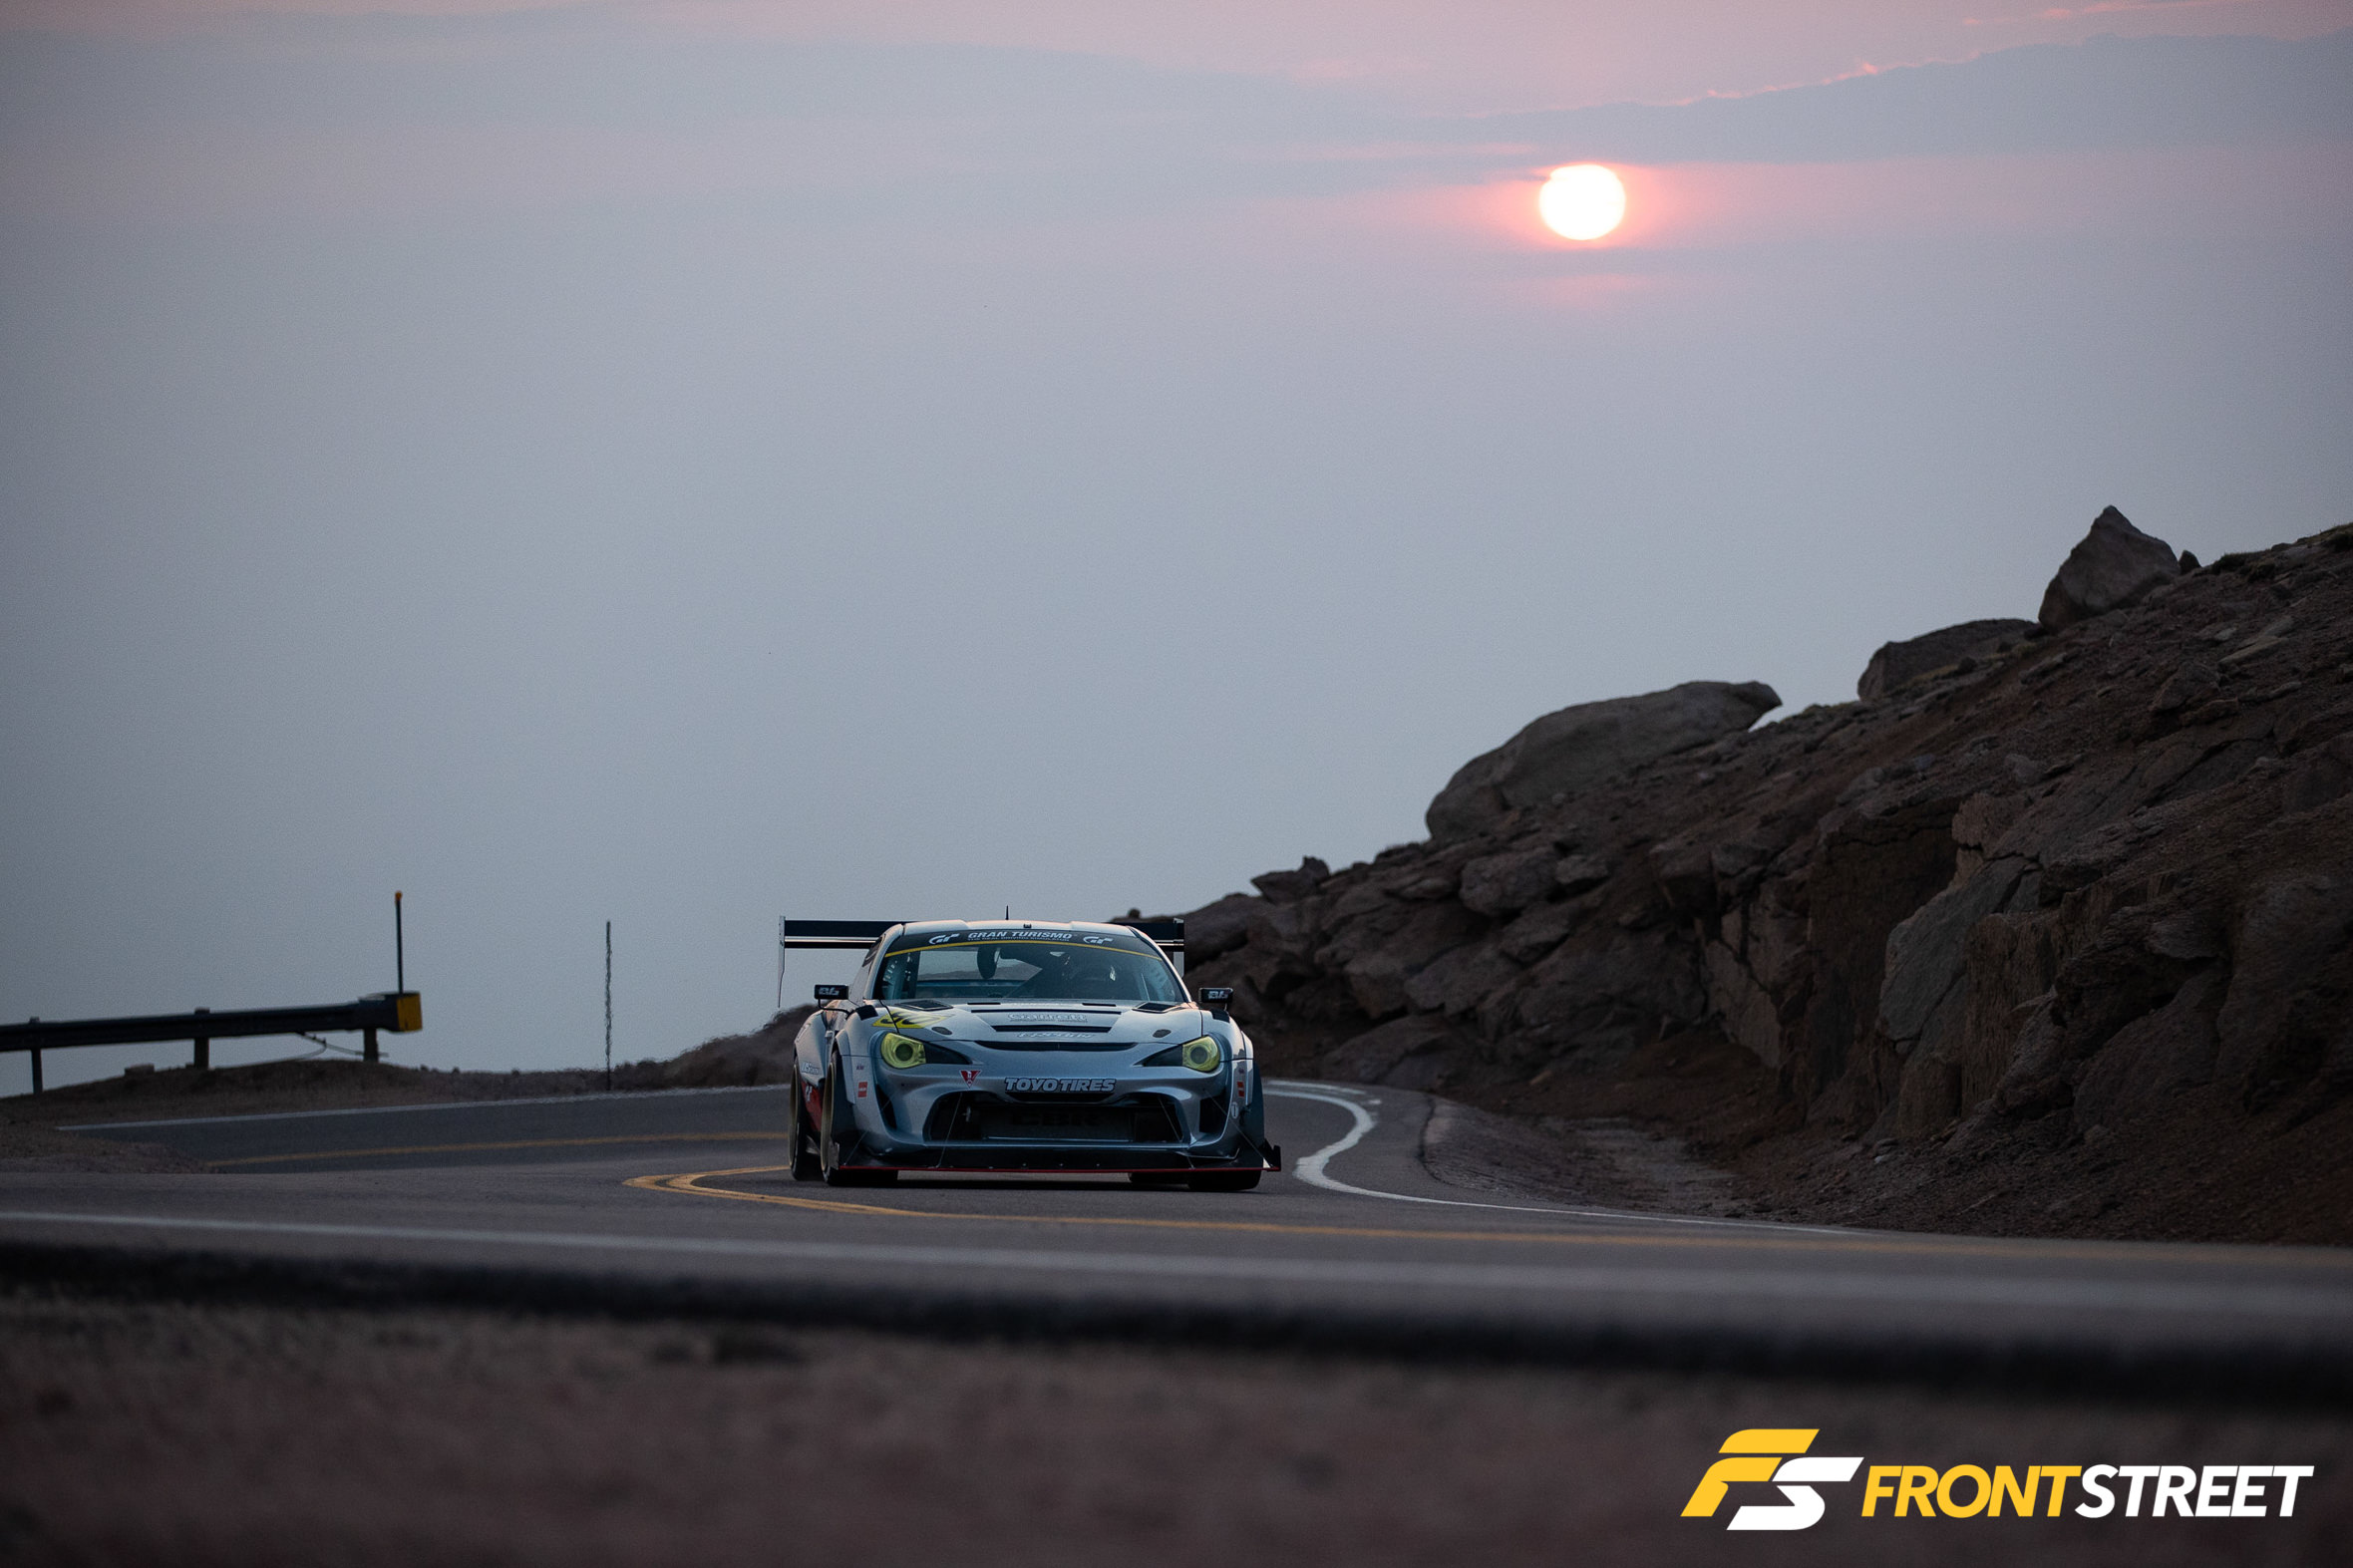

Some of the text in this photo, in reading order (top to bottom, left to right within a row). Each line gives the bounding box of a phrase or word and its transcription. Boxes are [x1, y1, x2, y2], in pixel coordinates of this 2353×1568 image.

[819, 986, 840, 996] 86
[1004, 1077, 1116, 1092] TOYO TIRES
